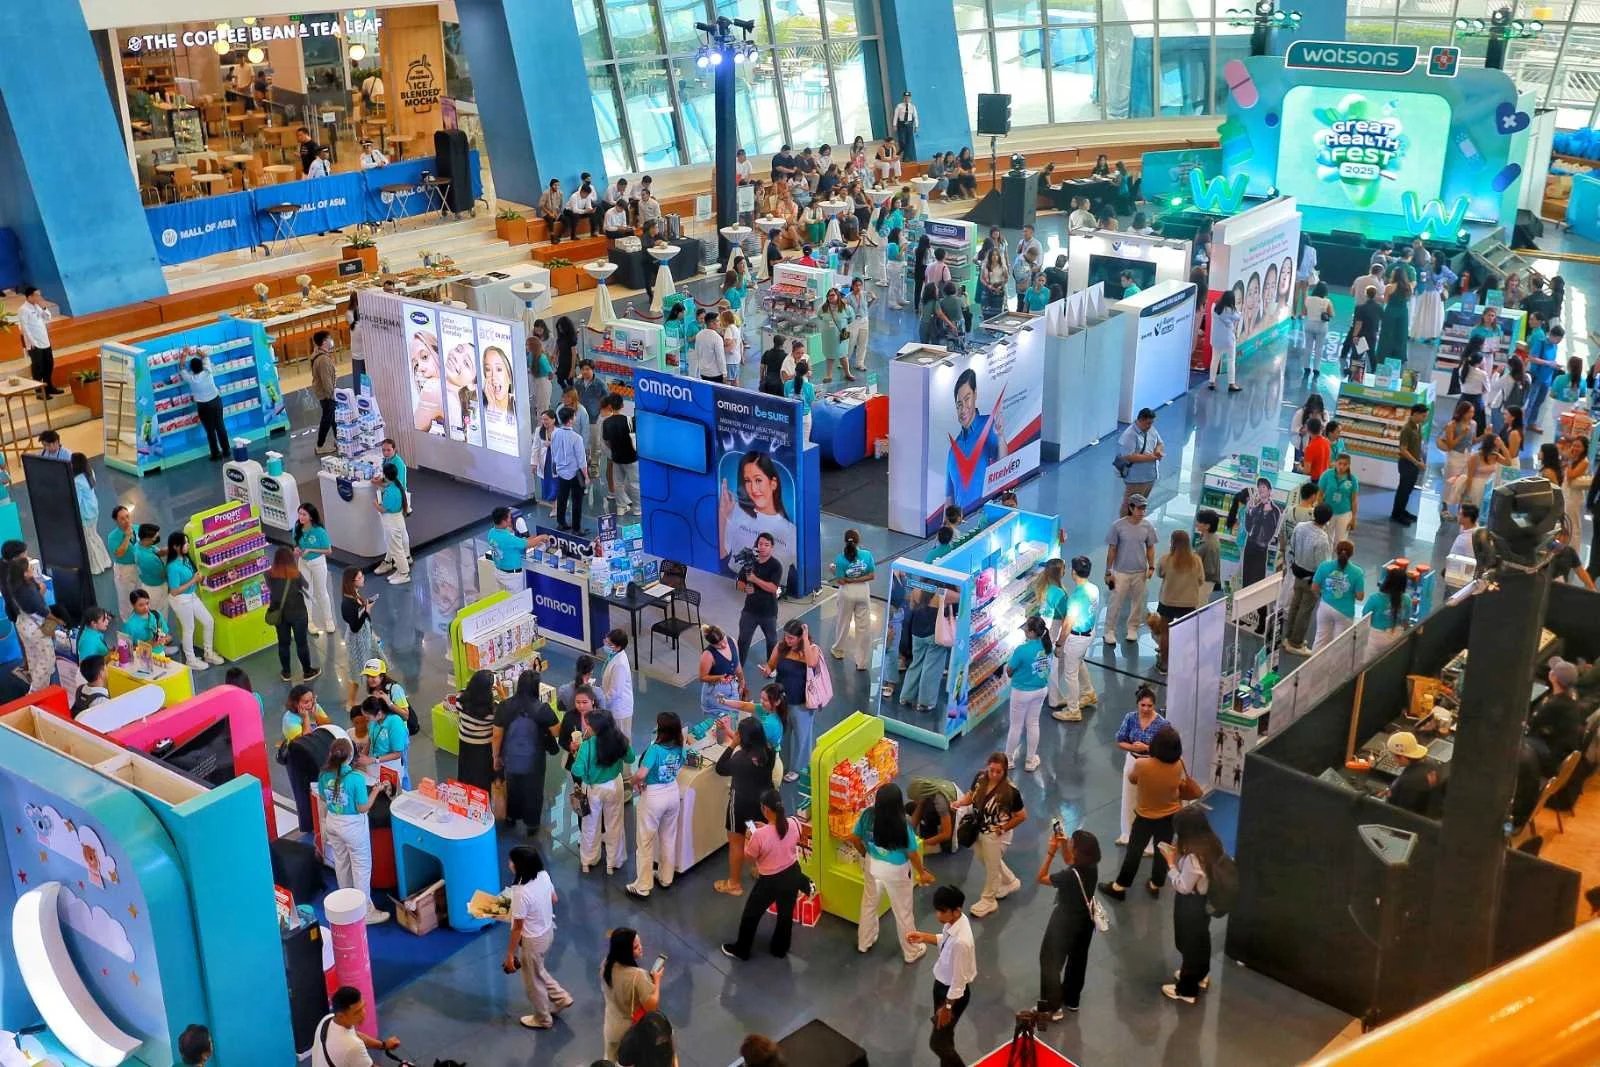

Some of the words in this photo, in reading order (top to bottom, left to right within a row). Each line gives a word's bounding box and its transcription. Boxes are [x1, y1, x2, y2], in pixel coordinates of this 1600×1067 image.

[142, 34, 178, 50] THE
[183, 27, 248, 47] COFFEE
[251, 26, 296, 42] BEAN
[310, 22, 341, 37] TEA
[345, 17, 383, 34] LEAF
[1302, 47, 1399, 67] watsons
[413, 81, 428, 90] ICE
[400, 89, 440, 100] BLENDED
[404, 97, 439, 107] MOCHA
[1344, 165, 1374, 176] 2025
[317, 200, 328, 209] OF
[329, 197, 347, 208] ASIA
[180, 227, 205, 240] MALL
[204, 222, 217, 234] OF
[216, 218, 237, 231] ASIA
